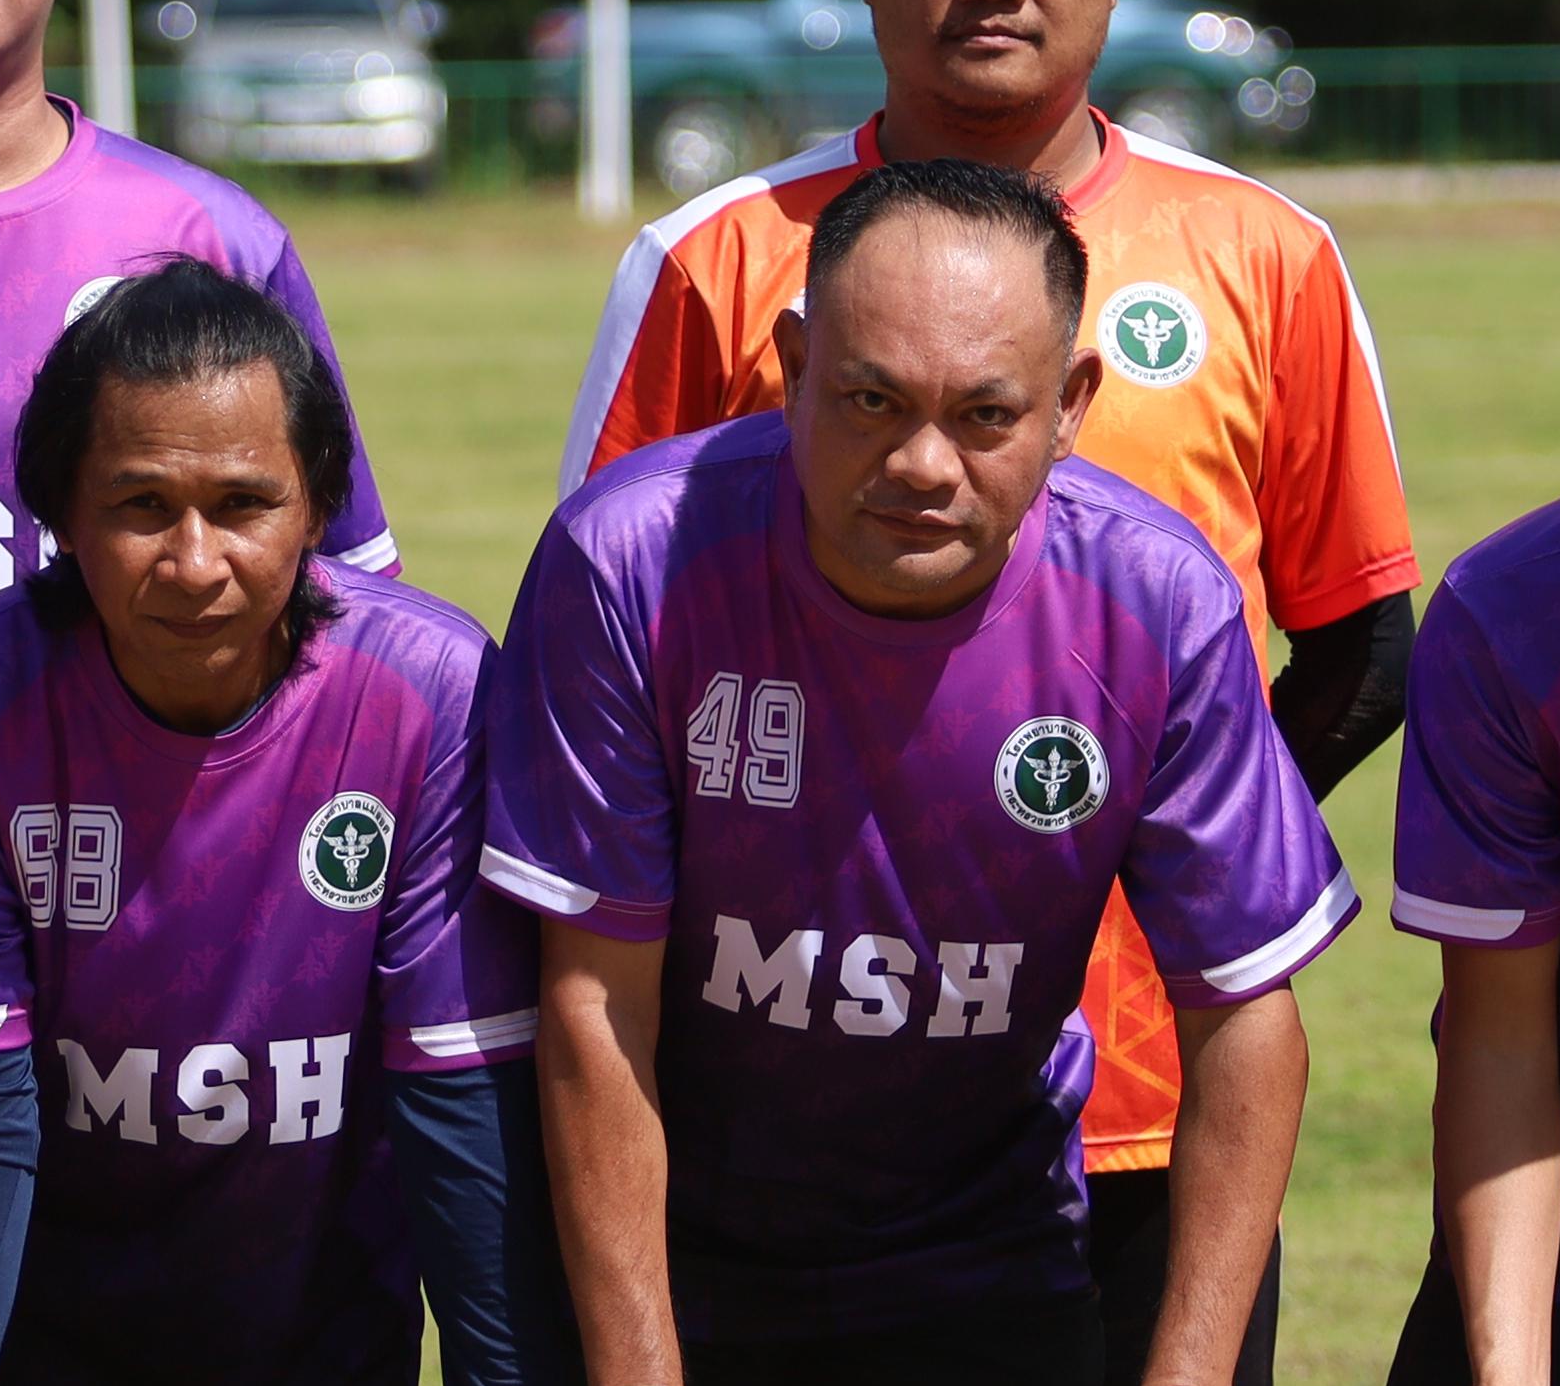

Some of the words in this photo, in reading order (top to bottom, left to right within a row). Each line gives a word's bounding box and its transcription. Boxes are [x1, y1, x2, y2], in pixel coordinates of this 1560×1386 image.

[686, 671, 805, 808] 49
[701, 914, 1024, 1039] MSH
[56, 1032, 353, 1146] MSH
